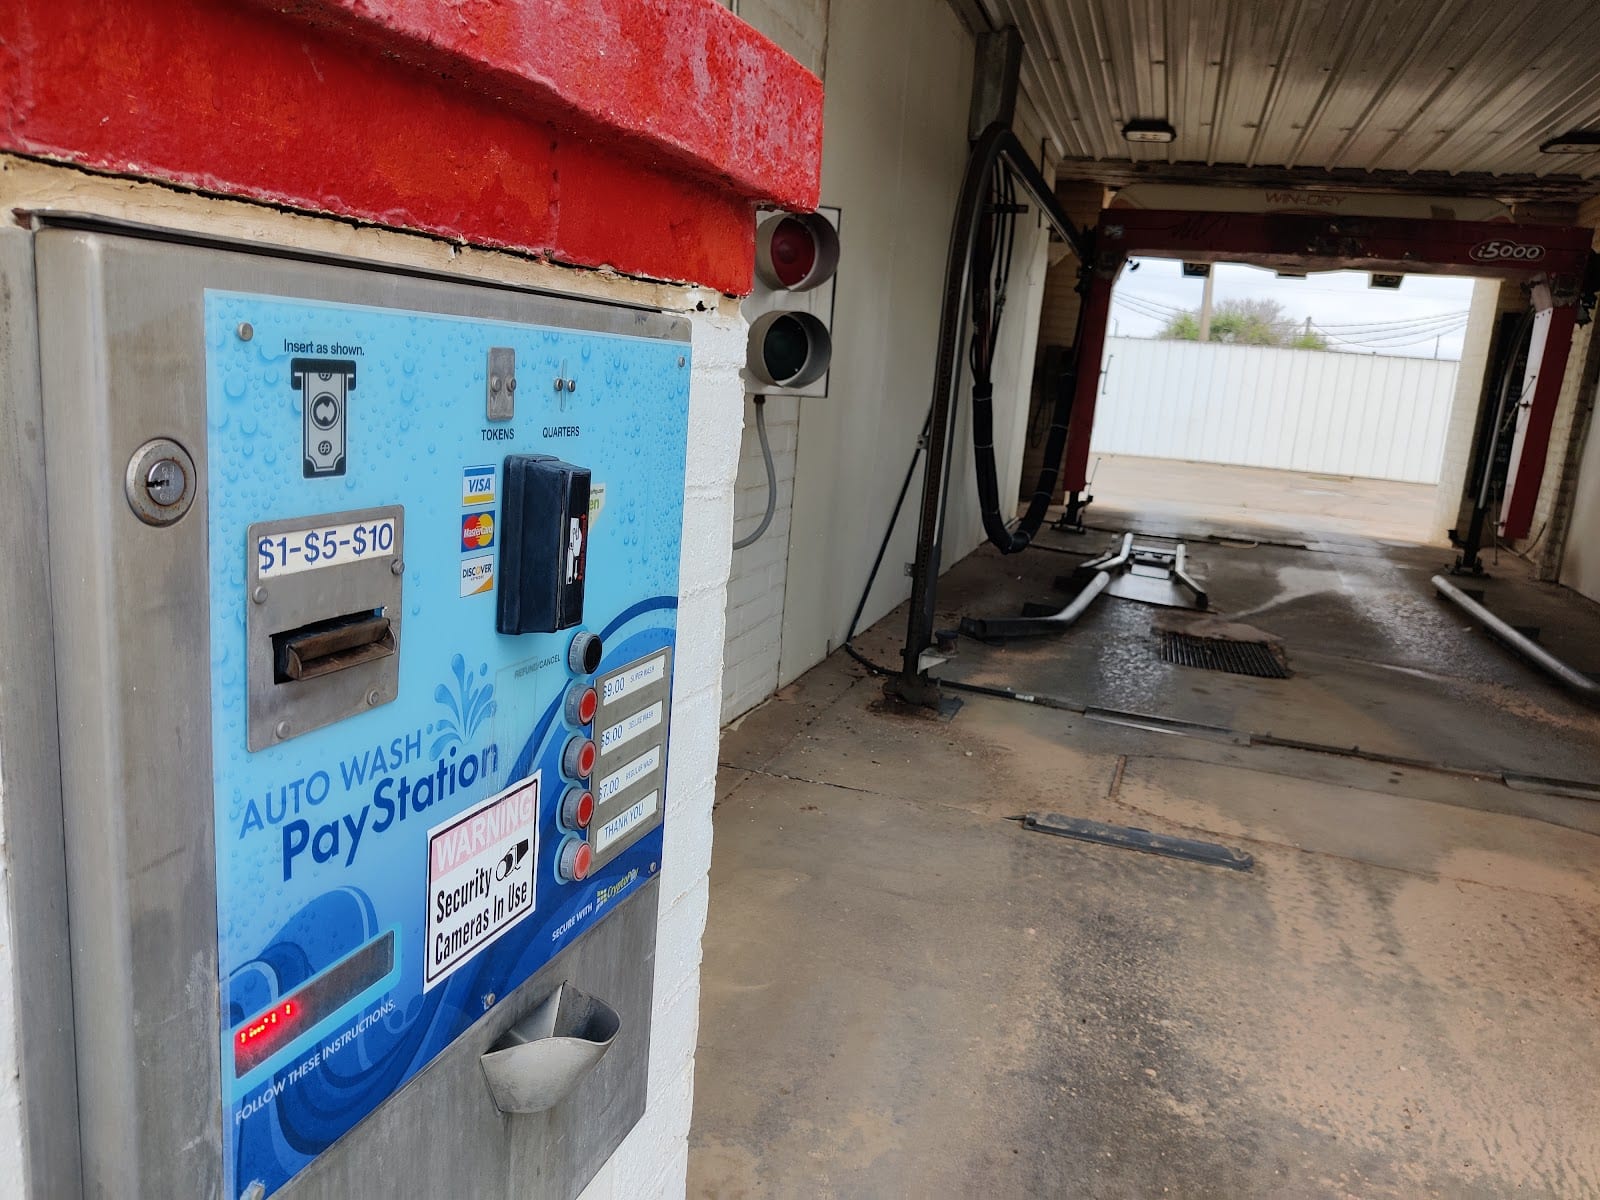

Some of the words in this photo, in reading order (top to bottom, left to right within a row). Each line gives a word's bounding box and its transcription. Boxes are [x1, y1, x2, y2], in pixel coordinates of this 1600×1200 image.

[1477, 242, 1540, 259] i5000
[284, 338, 313, 353] Insert
[316, 344, 328, 354] as
[330, 341, 365, 356] shown.
[481, 428, 515, 441] TOKENS
[542, 425, 580, 438] QUARTERS
[469, 478, 491, 493] VISA
[258, 523, 393, 573] $1-$5-$10
[463, 525, 493, 538] MasterCard
[462, 563, 492, 578] DISCOVER
[239, 770, 330, 840] AUTO
[340, 729, 421, 791] WASH
[283, 743, 499, 882] PayStation
[604, 812, 629, 840] THANK
[630, 802, 644, 822] YOU
[436, 791, 534, 873] WARNING
[436, 866, 493, 924] Security
[435, 909, 489, 966] Cameras
[493, 894, 504, 923] In
[508, 881, 527, 914] Use
[552, 916, 575, 941] SECURE
[576, 902, 593, 922] WITH
[235, 1079, 286, 1126] FOLLOW
[288, 1054, 321, 1085] THESE
[322, 999, 396, 1061] INSTRUCTIONS.
